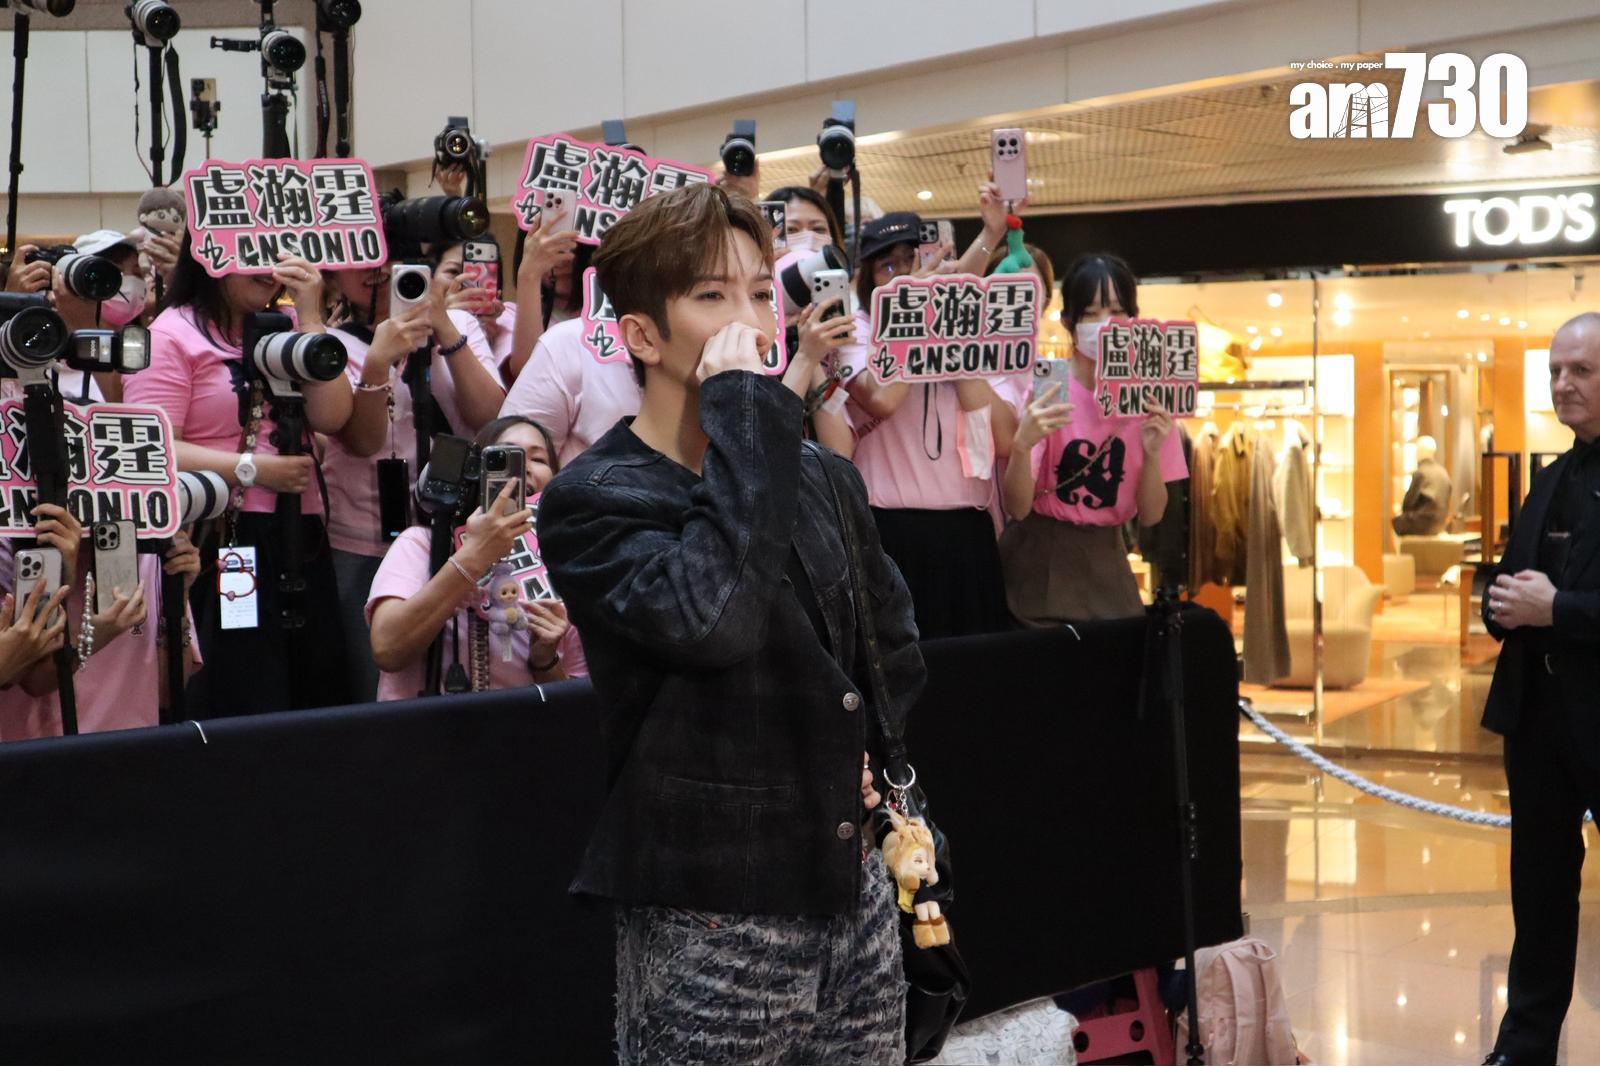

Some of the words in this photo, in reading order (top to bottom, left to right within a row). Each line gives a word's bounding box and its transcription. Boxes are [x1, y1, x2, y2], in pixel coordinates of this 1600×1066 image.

[192, 167, 377, 228] 盧瀚霆
[1443, 192, 1596, 248] TOD'S
[349, 229, 381, 263] LO
[877, 283, 1034, 340] 盧瀚霆
[907, 343, 1000, 375] ANSON
[1004, 341, 1031, 371] LO
[1102, 326, 1197, 378] 盧瀚霆
[1178, 384, 1195, 414] LO
